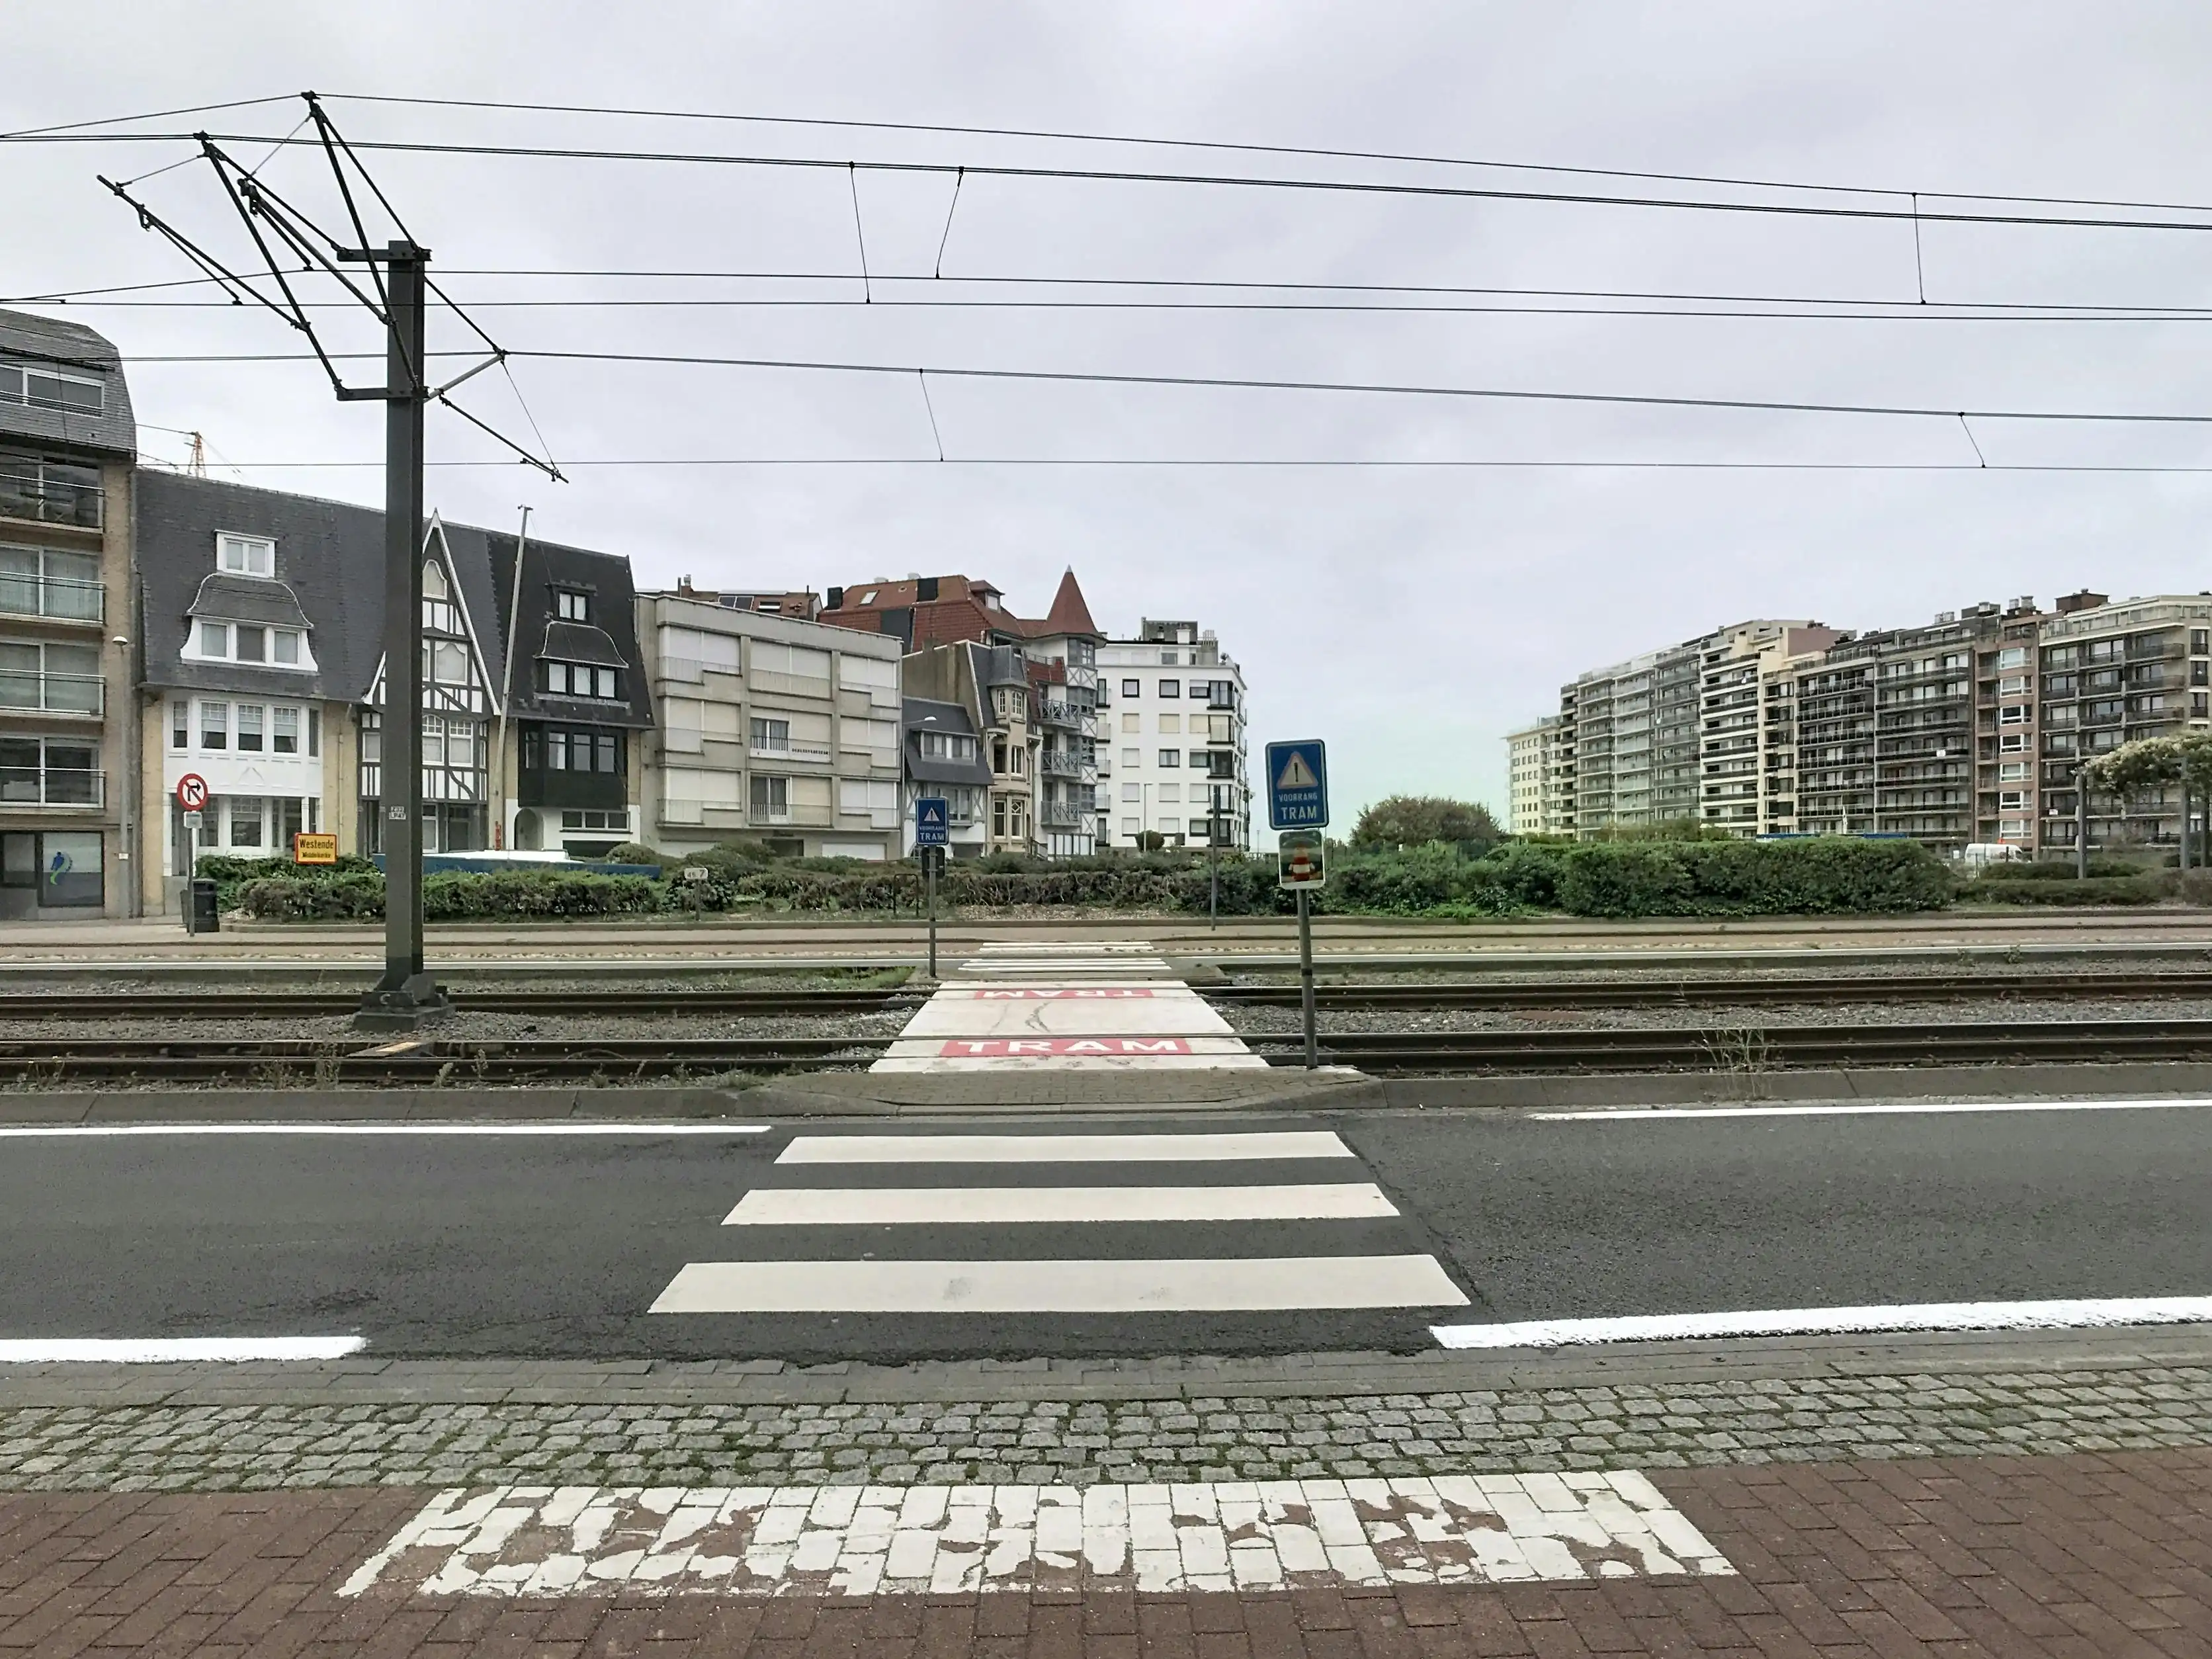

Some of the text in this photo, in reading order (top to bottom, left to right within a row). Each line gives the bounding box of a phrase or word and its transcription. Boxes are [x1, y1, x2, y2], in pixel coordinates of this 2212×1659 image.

[1279, 792, 1317, 802] VOORRANG
[1281, 805, 1316, 820] TRAM
[300, 839, 333, 849] Westende
[957, 1041, 1178, 1052] TRAM
